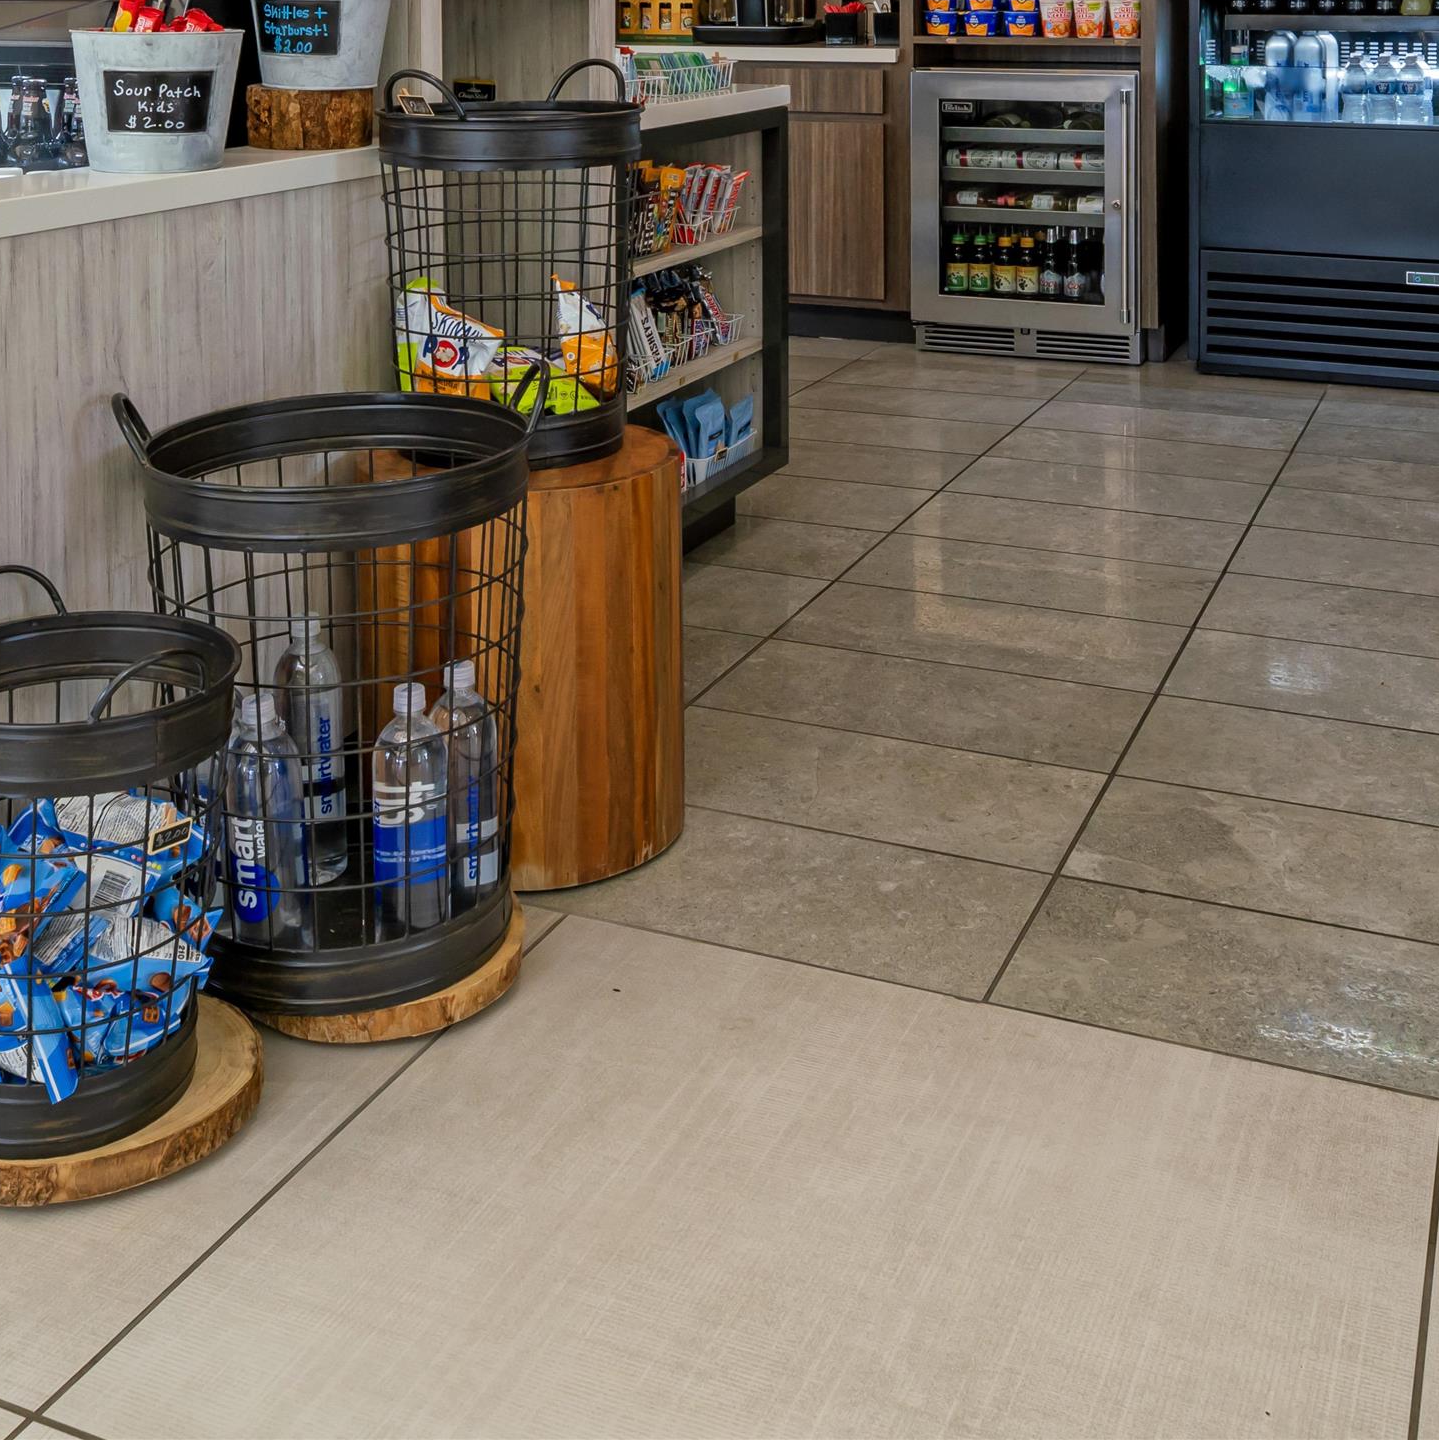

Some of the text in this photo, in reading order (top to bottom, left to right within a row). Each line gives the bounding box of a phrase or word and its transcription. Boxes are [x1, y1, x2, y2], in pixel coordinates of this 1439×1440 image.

[264, 4, 310, 20] Skittles
[264, 21, 329, 37] Starburst!
[274, 35, 312, 53] $2.00
[113, 79, 201, 98] Sour Patch
[137, 101, 174, 113] Kids
[231, 817, 258, 909] smart
